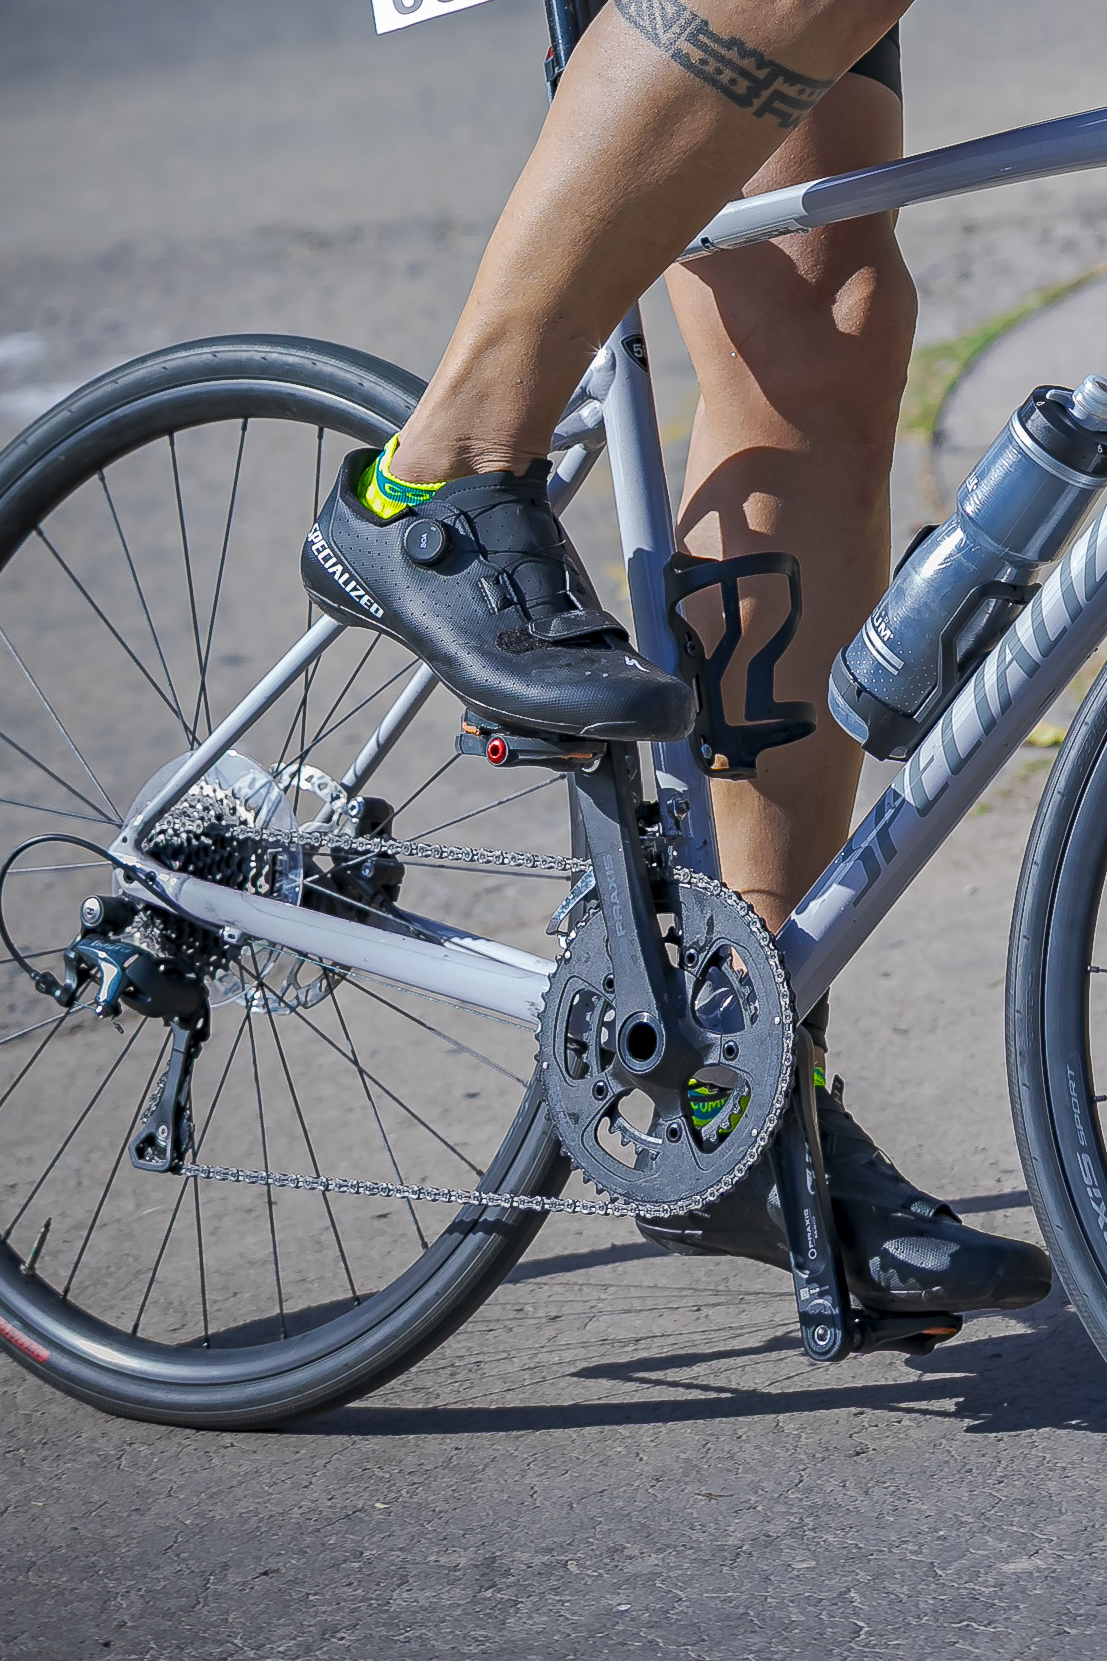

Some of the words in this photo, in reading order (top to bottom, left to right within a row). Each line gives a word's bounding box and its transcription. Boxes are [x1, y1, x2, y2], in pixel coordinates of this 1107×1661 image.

[308, 523, 384, 619] SPECIALIZED
[420, 532, 428, 549] BOA
[603, 854, 625, 937] PRAXIS
[1066, 1063, 1088, 1147] SPORT
[803, 1208, 815, 1249] PRAXIS
